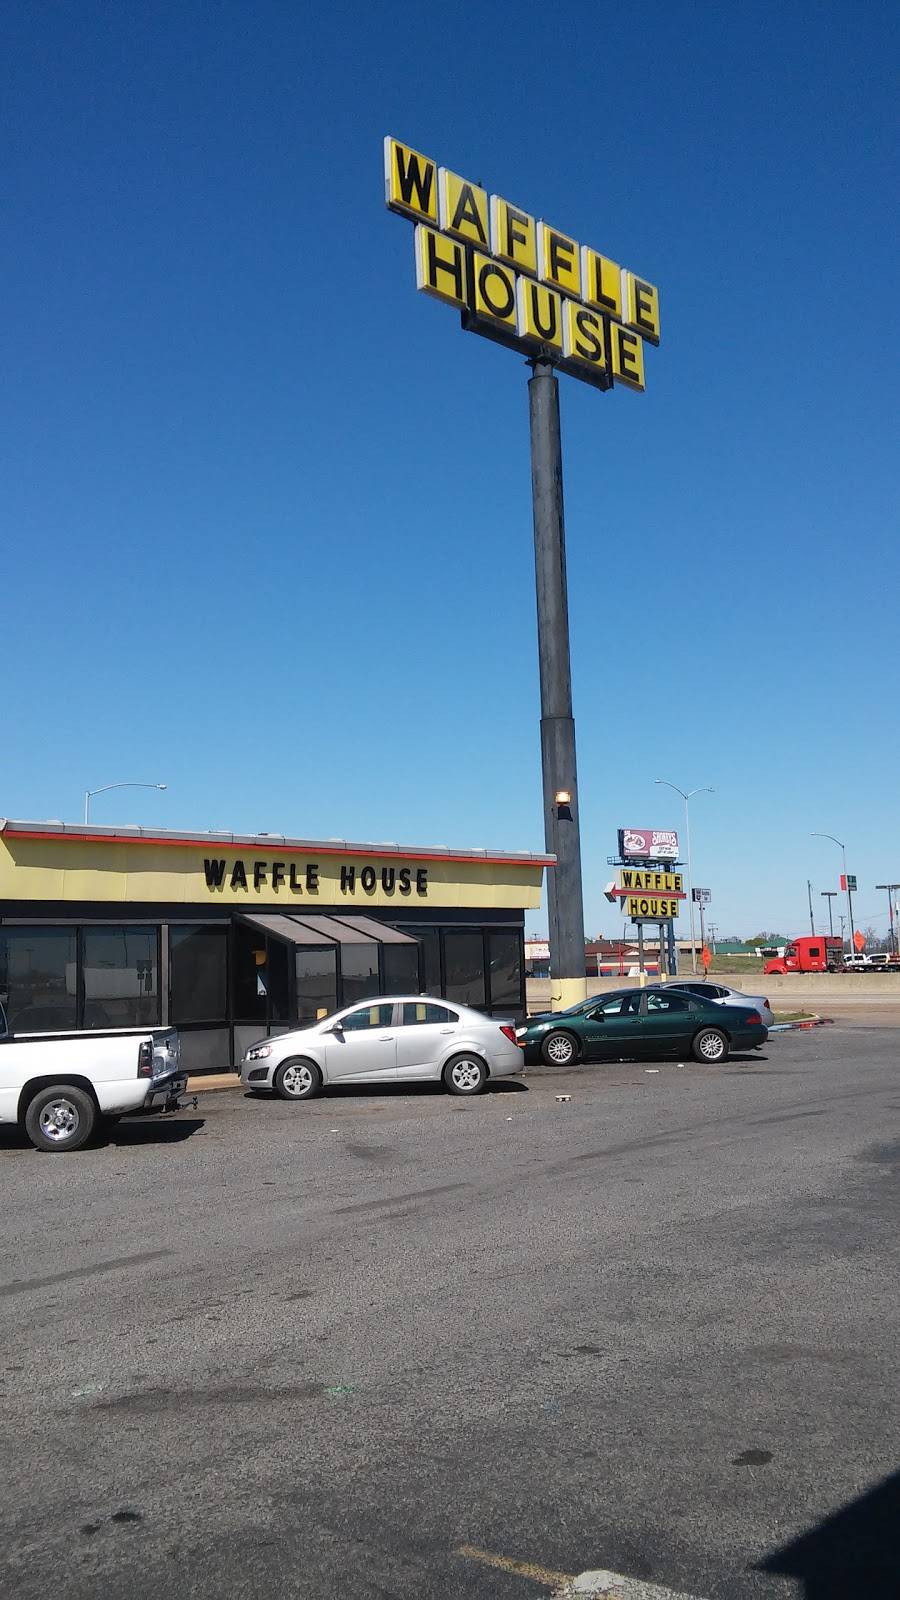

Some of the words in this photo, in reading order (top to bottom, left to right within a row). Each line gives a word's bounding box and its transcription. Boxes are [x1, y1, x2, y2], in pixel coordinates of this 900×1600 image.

[395, 145, 655, 332] WAFFLE
[428, 233, 640, 382] HOUSE
[203, 858, 319, 889] WAFFLE
[340, 865, 428, 892] HOUSE
[622, 871, 681, 891] WAFFLE
[630, 899, 677, 916] HOUSE
